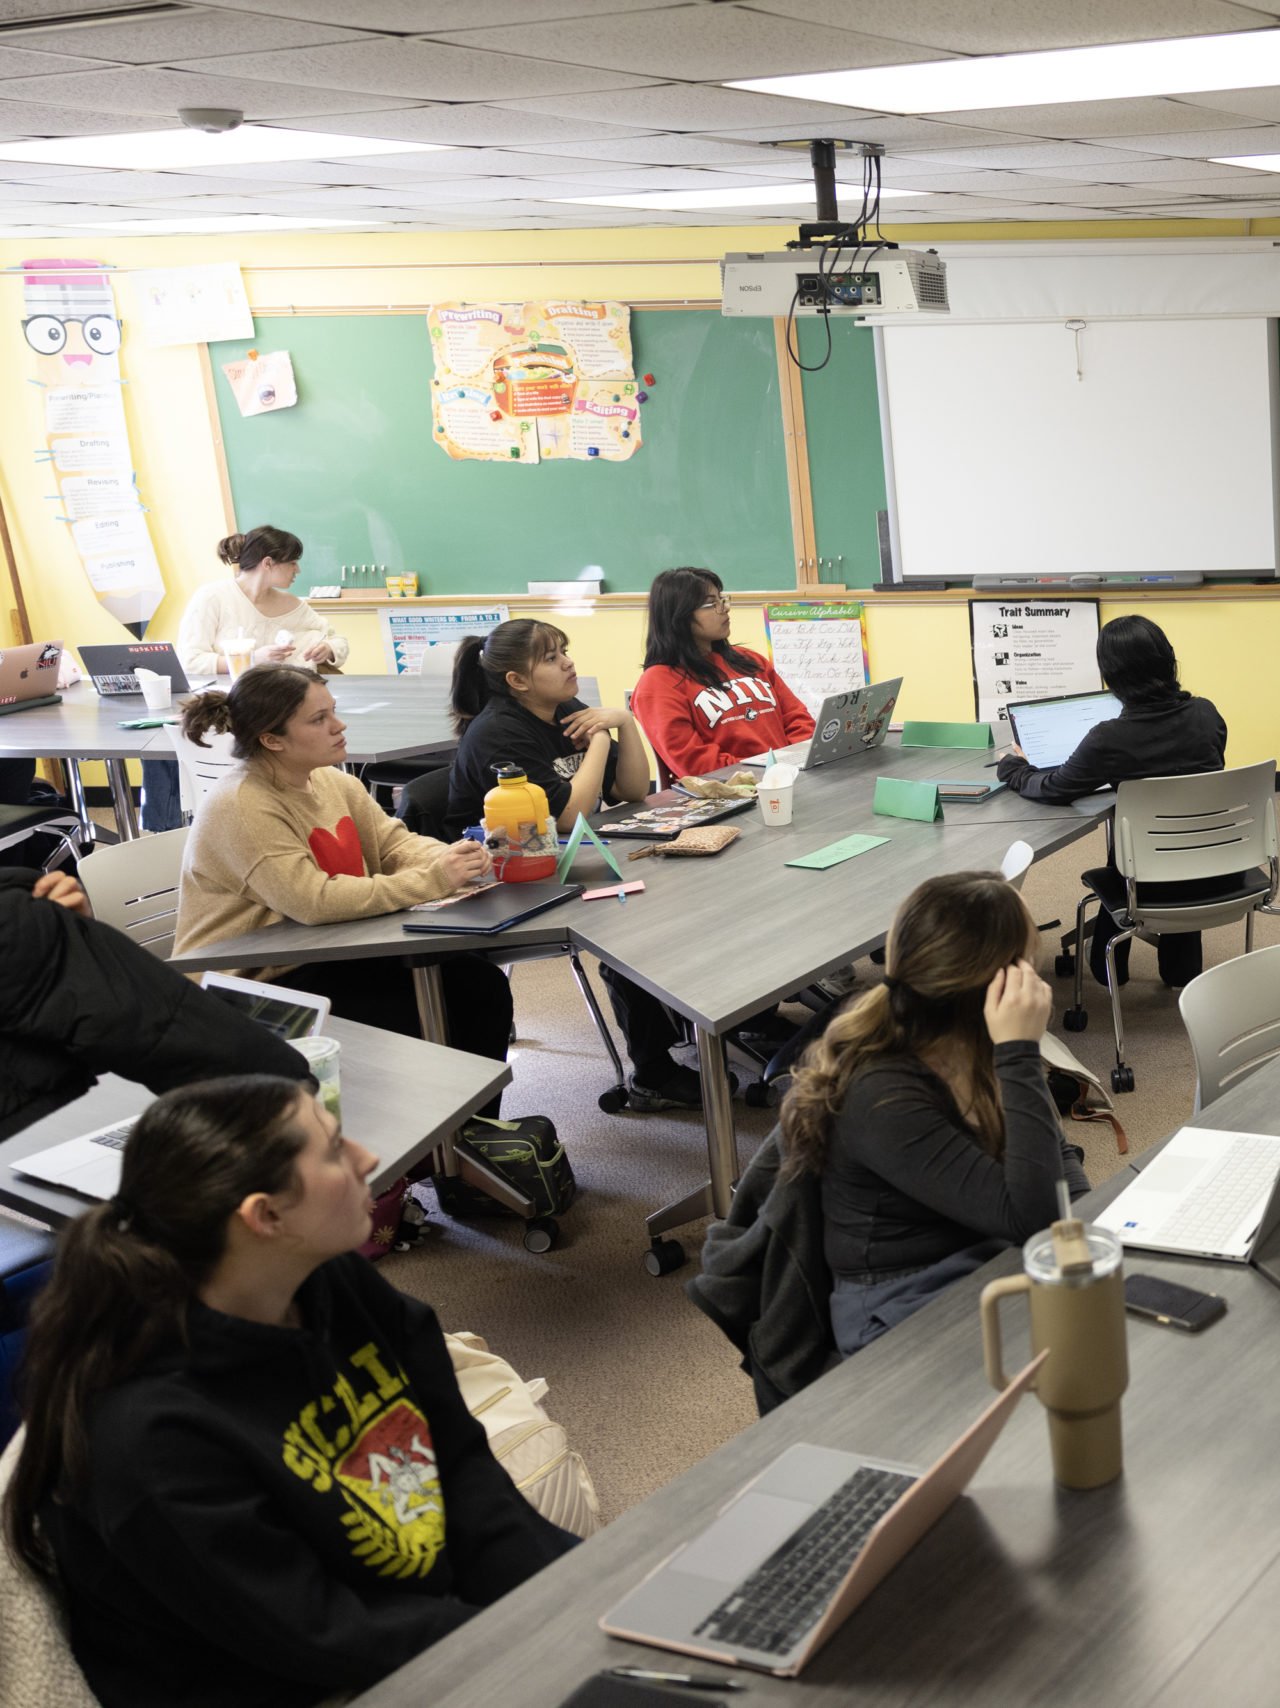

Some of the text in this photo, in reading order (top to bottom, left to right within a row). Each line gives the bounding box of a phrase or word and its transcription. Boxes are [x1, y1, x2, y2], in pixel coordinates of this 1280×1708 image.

[440, 309, 500, 323] Prewriting
[548, 305, 599, 319] Drafting
[586, 401, 629, 417] Editing
[770, 606, 854, 618] Cursive Alphabet
[999, 606, 1071, 618] Trait Summary
[391, 616, 407, 624] WHAT
[424, 615, 447, 623] WRITERS
[461, 614, 478, 622] FROM
[37, 657, 57, 668] NIU
[693, 676, 777, 729] NIU
